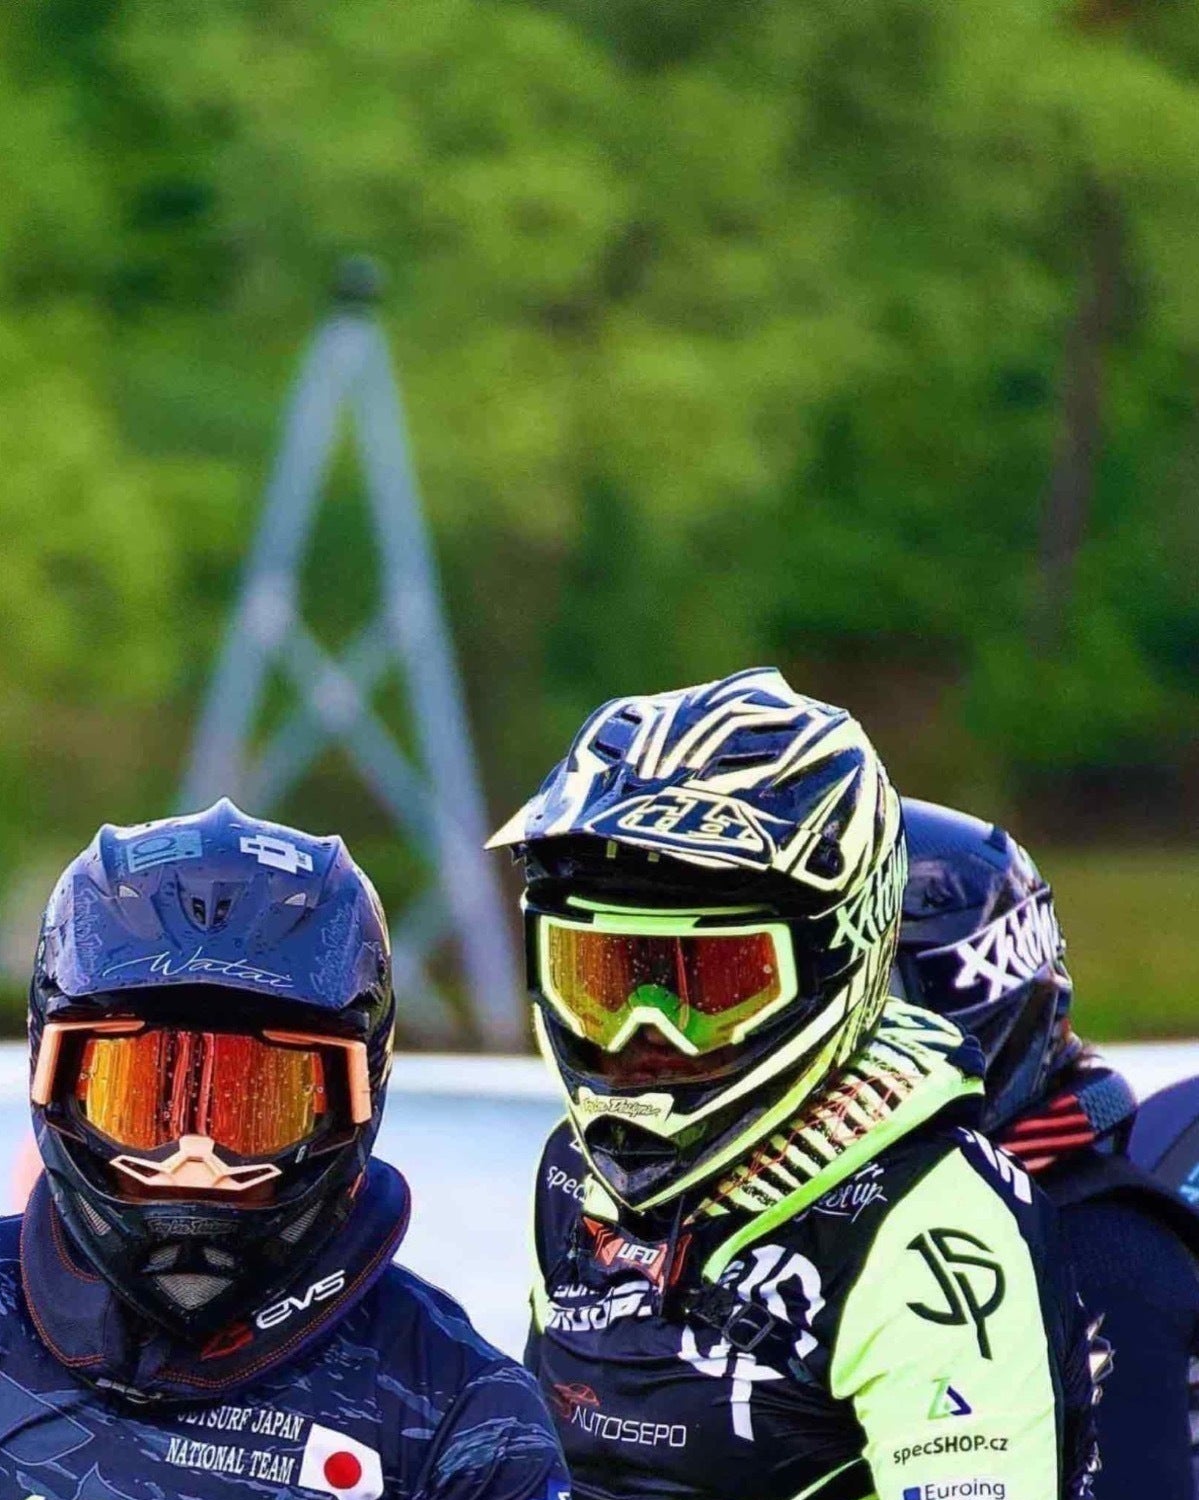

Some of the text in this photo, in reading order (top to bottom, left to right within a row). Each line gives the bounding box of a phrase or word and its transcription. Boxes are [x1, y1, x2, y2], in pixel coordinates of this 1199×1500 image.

[548, 1165, 587, 1201] spec
[251, 1410, 304, 1442] JAPAN
[571, 1405, 687, 1447] AUTOSEPO
[165, 1437, 296, 1485] NATIONAL TEAM
[893, 1435, 1009, 1466] specSHOP.cz
[925, 1479, 1006, 1500] Euroing
